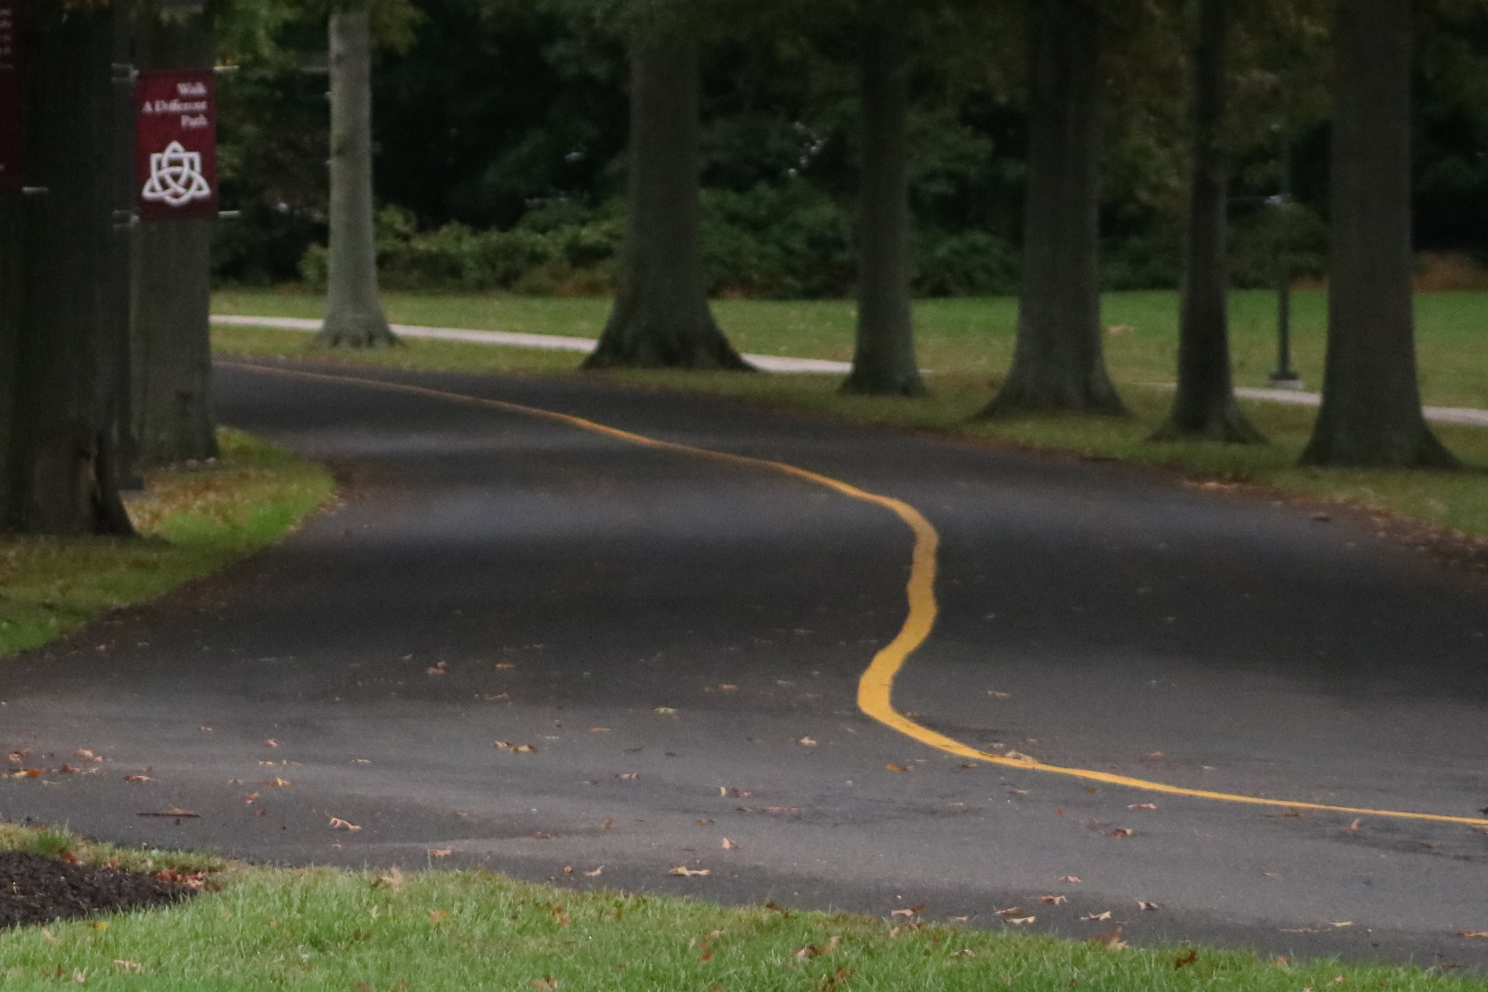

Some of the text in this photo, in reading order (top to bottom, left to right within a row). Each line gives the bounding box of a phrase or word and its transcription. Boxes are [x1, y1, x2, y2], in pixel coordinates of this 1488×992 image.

[177, 81, 207, 96] Walk
[142, 99, 208, 113] A Different
[181, 114, 209, 128] Path
